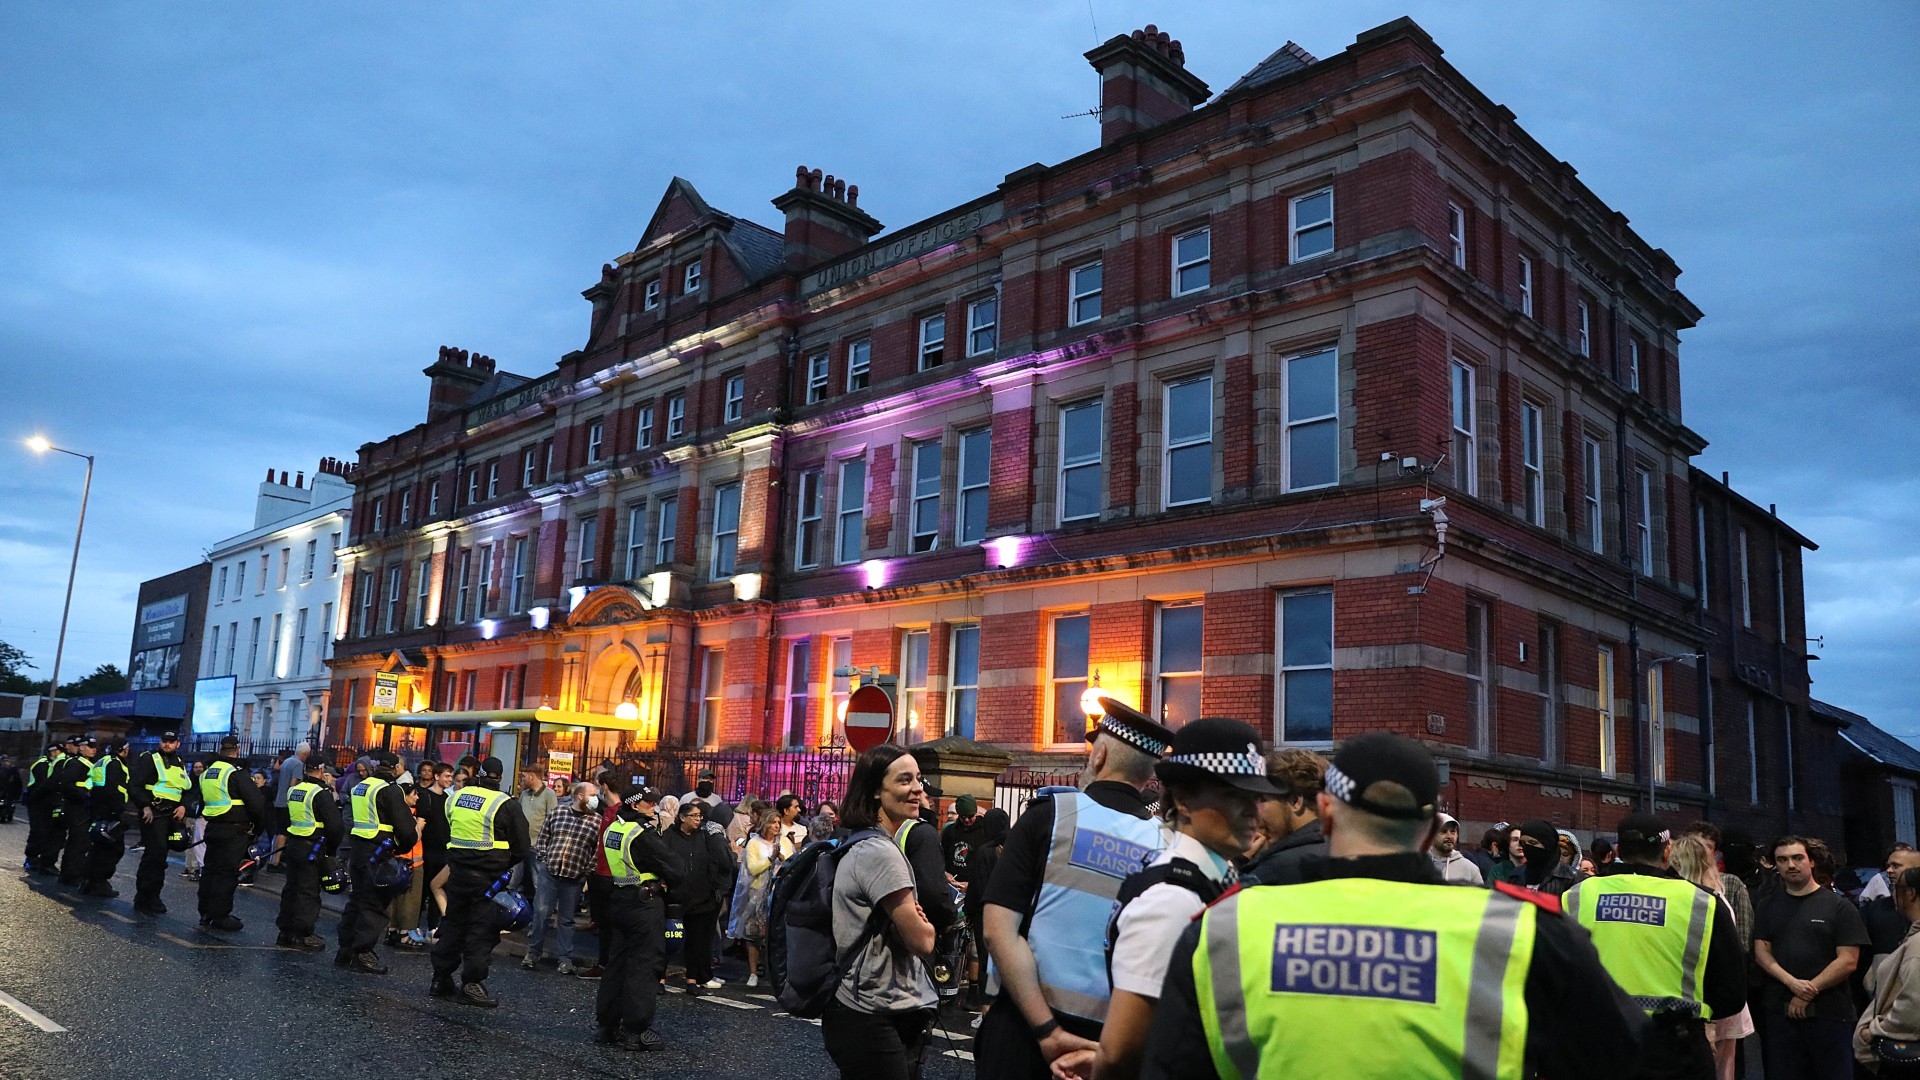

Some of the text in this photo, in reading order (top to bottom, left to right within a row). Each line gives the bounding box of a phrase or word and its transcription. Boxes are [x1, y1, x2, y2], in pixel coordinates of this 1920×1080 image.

[817, 210, 982, 288] UNION OFFICES
[478, 399, 507, 421] WEST
[550, 758, 571, 767] Refugees
[457, 800, 480, 810] POLICE
[460, 794, 485, 804] HEDDLU
[1598, 895, 1665, 911] HEDDLU
[1601, 907, 1659, 924] POLICE
[1277, 927, 1433, 964] HEDDLU
[1286, 957, 1422, 997] POLICE
